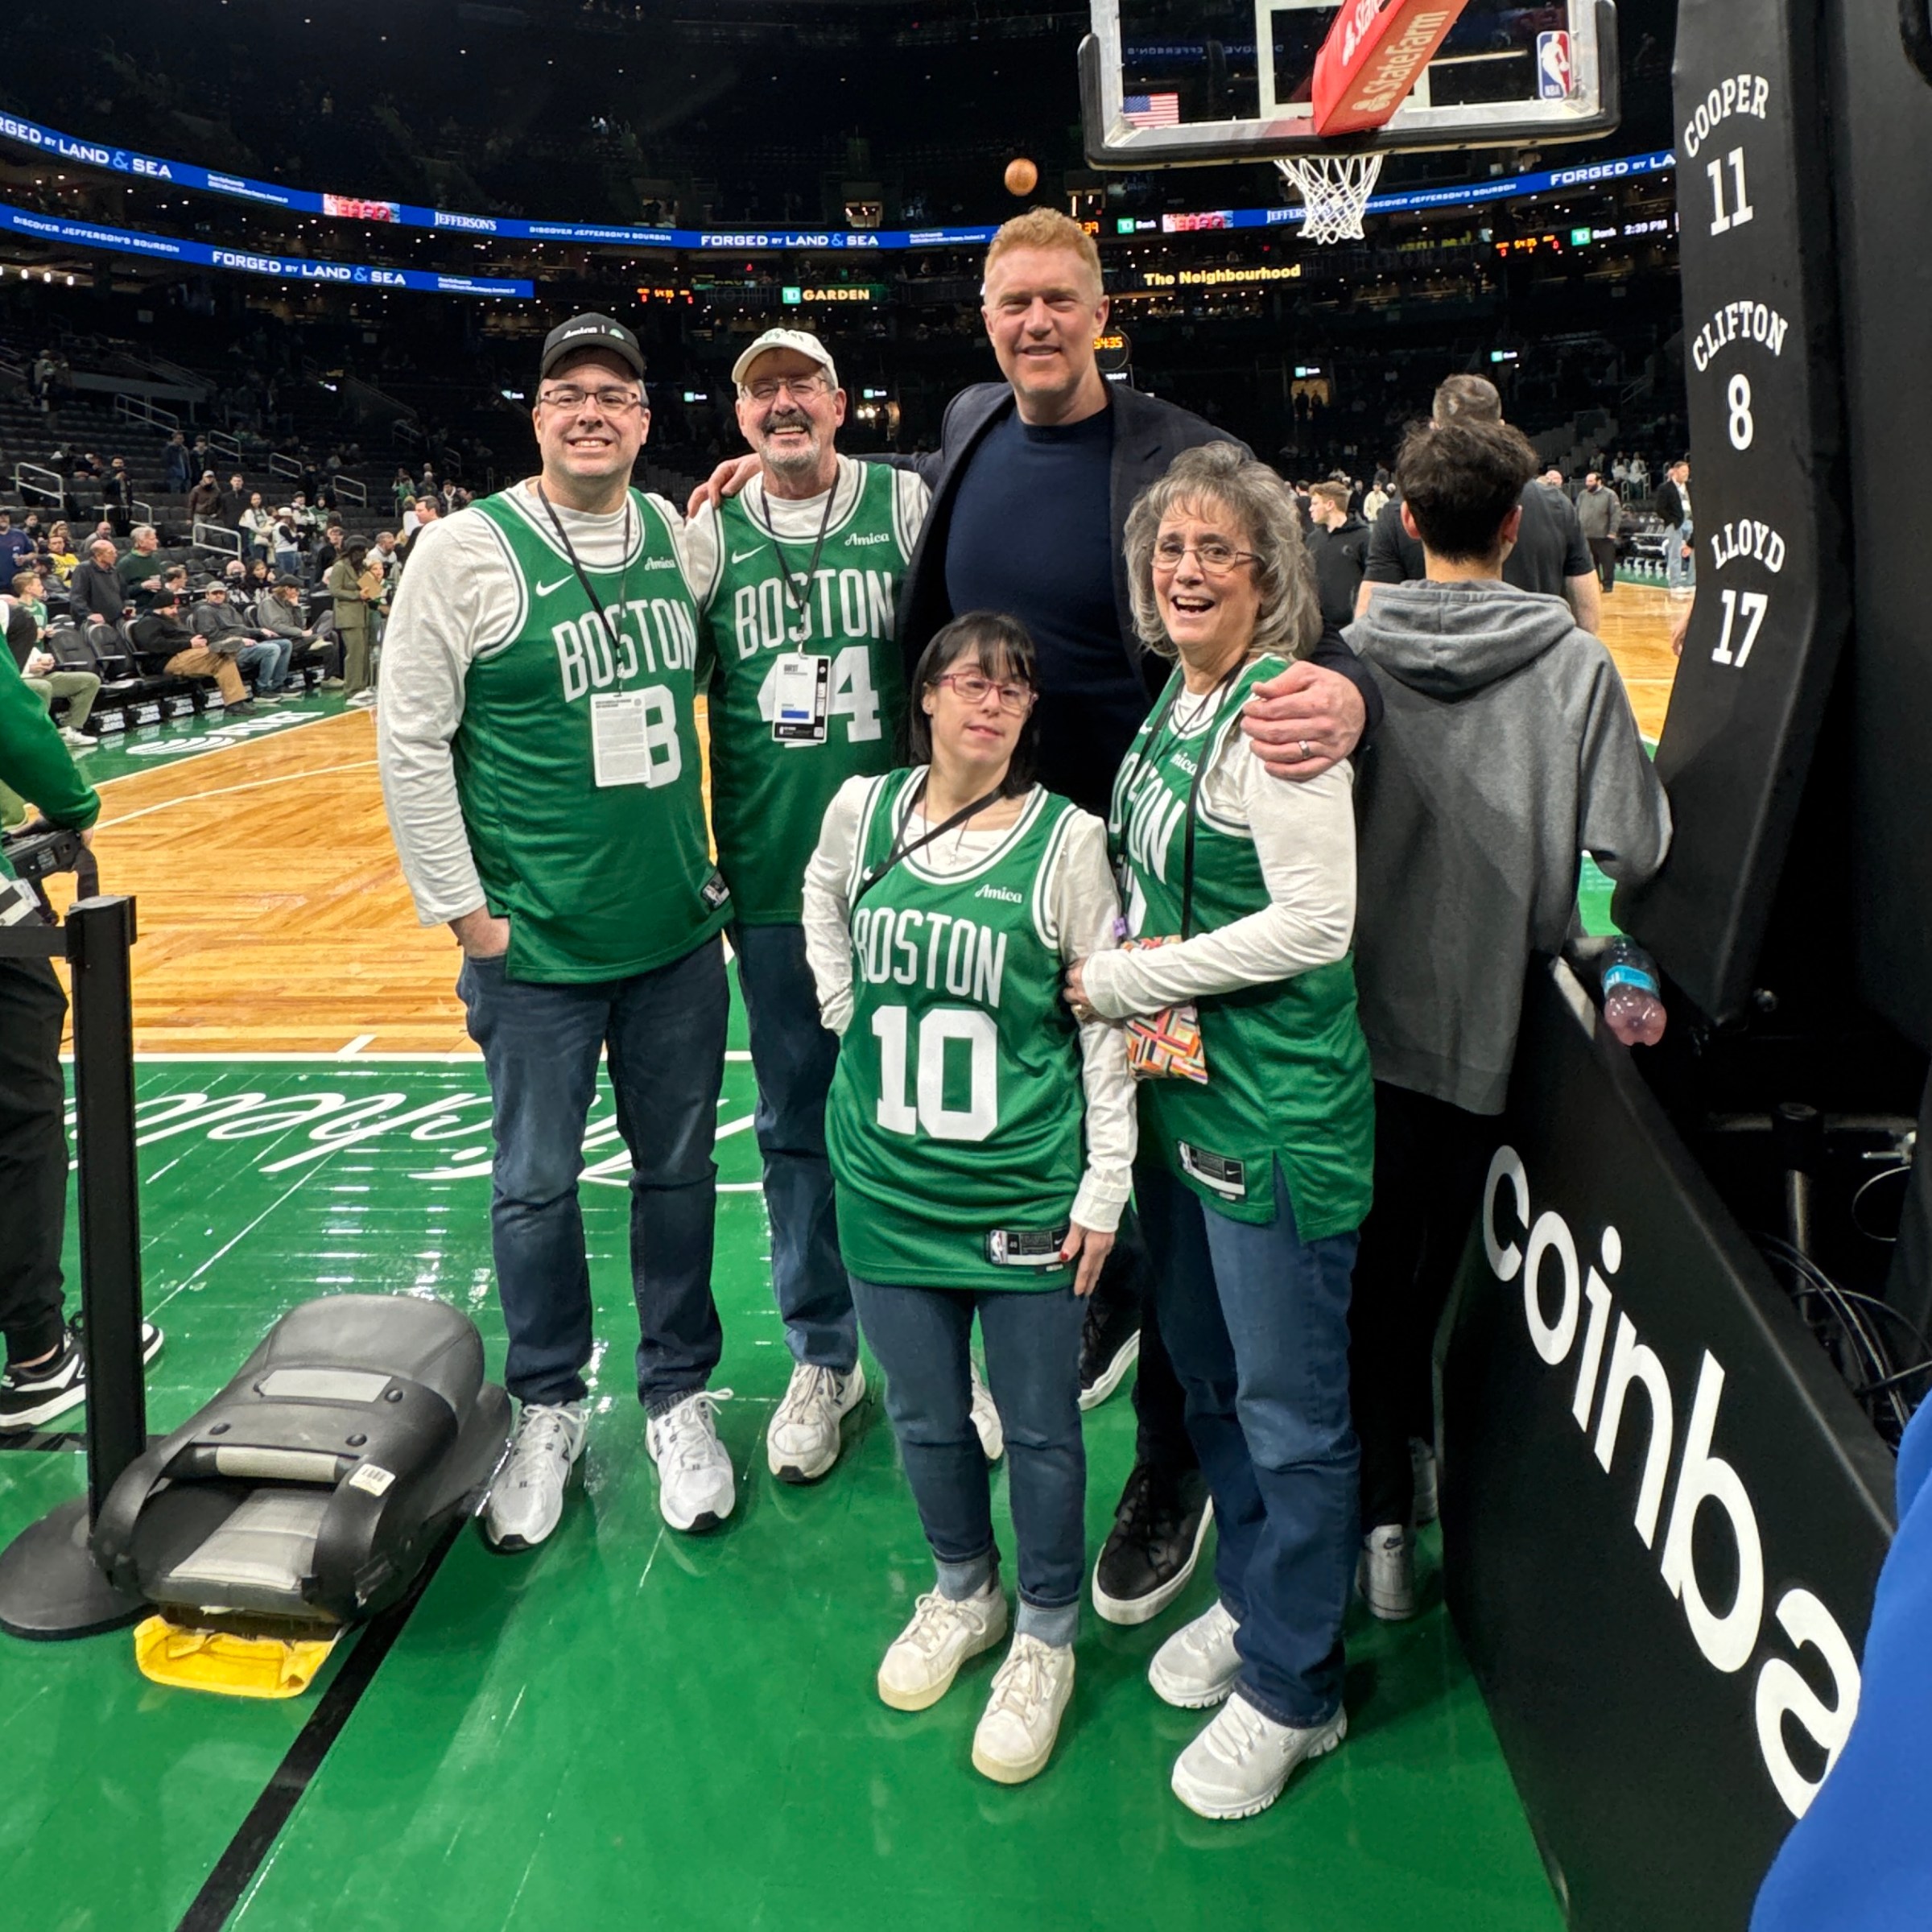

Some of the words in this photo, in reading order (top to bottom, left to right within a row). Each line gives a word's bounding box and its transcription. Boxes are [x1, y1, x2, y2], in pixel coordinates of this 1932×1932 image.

[1685, 74, 1769, 159] COOPER
[44, 137, 57, 147] BY
[59, 138, 109, 164] LAND
[113, 151, 129, 171] &
[132, 158, 172, 179] SEA
[1550, 162, 1629, 186] FORGED
[1633, 161, 1647, 170] BY
[1364, 198, 1408, 209] ISCOVER
[1410, 190, 1470, 204] JEFFERSON'S
[1472, 184, 1517, 196] BOURBON
[1707, 147, 1753, 236] 11
[13, 216, 60, 233] DISCOVER
[62, 227, 130, 245] JEFFERSON'S
[134, 238, 180, 254] BOURBON
[434, 212, 497, 231] JEFFERSON'S
[530, 226, 572, 235] DISCOVER
[632, 233, 671, 241] BOURBON
[1136, 220, 1156, 229] Bank
[1592, 227, 1616, 239] Bank
[1624, 223, 1648, 235] 2:39
[1649, 219, 1668, 231] PM
[701, 235, 768, 246] FORGED
[786, 235, 829, 246] LAND
[832, 233, 844, 246] &
[847, 235, 879, 246] SEA
[213, 250, 282, 273] FORGED
[302, 264, 351, 279] LAND
[354, 266, 367, 283] &
[371, 270, 406, 285] SEA
[1144, 274, 1175, 286] The
[1179, 263, 1301, 285] Neighbourhood
[803, 289, 870, 301] GARDEN
[1693, 300, 1788, 373] CLIFTON
[1728, 374, 1753, 451] 8
[844, 532, 890, 546] Amica
[1711, 518, 1786, 574] LLOYD
[644, 556, 676, 570] Amica
[734, 568, 895, 661] BOSTON
[1711, 588, 1769, 668] 17
[551, 598, 696, 704] BOSTON
[975, 884, 1022, 904] Amica
[853, 907, 1008, 1009] BOSTON
[872, 1005, 998, 1141] 10
[1484, 1145, 1861, 1821] coinba
